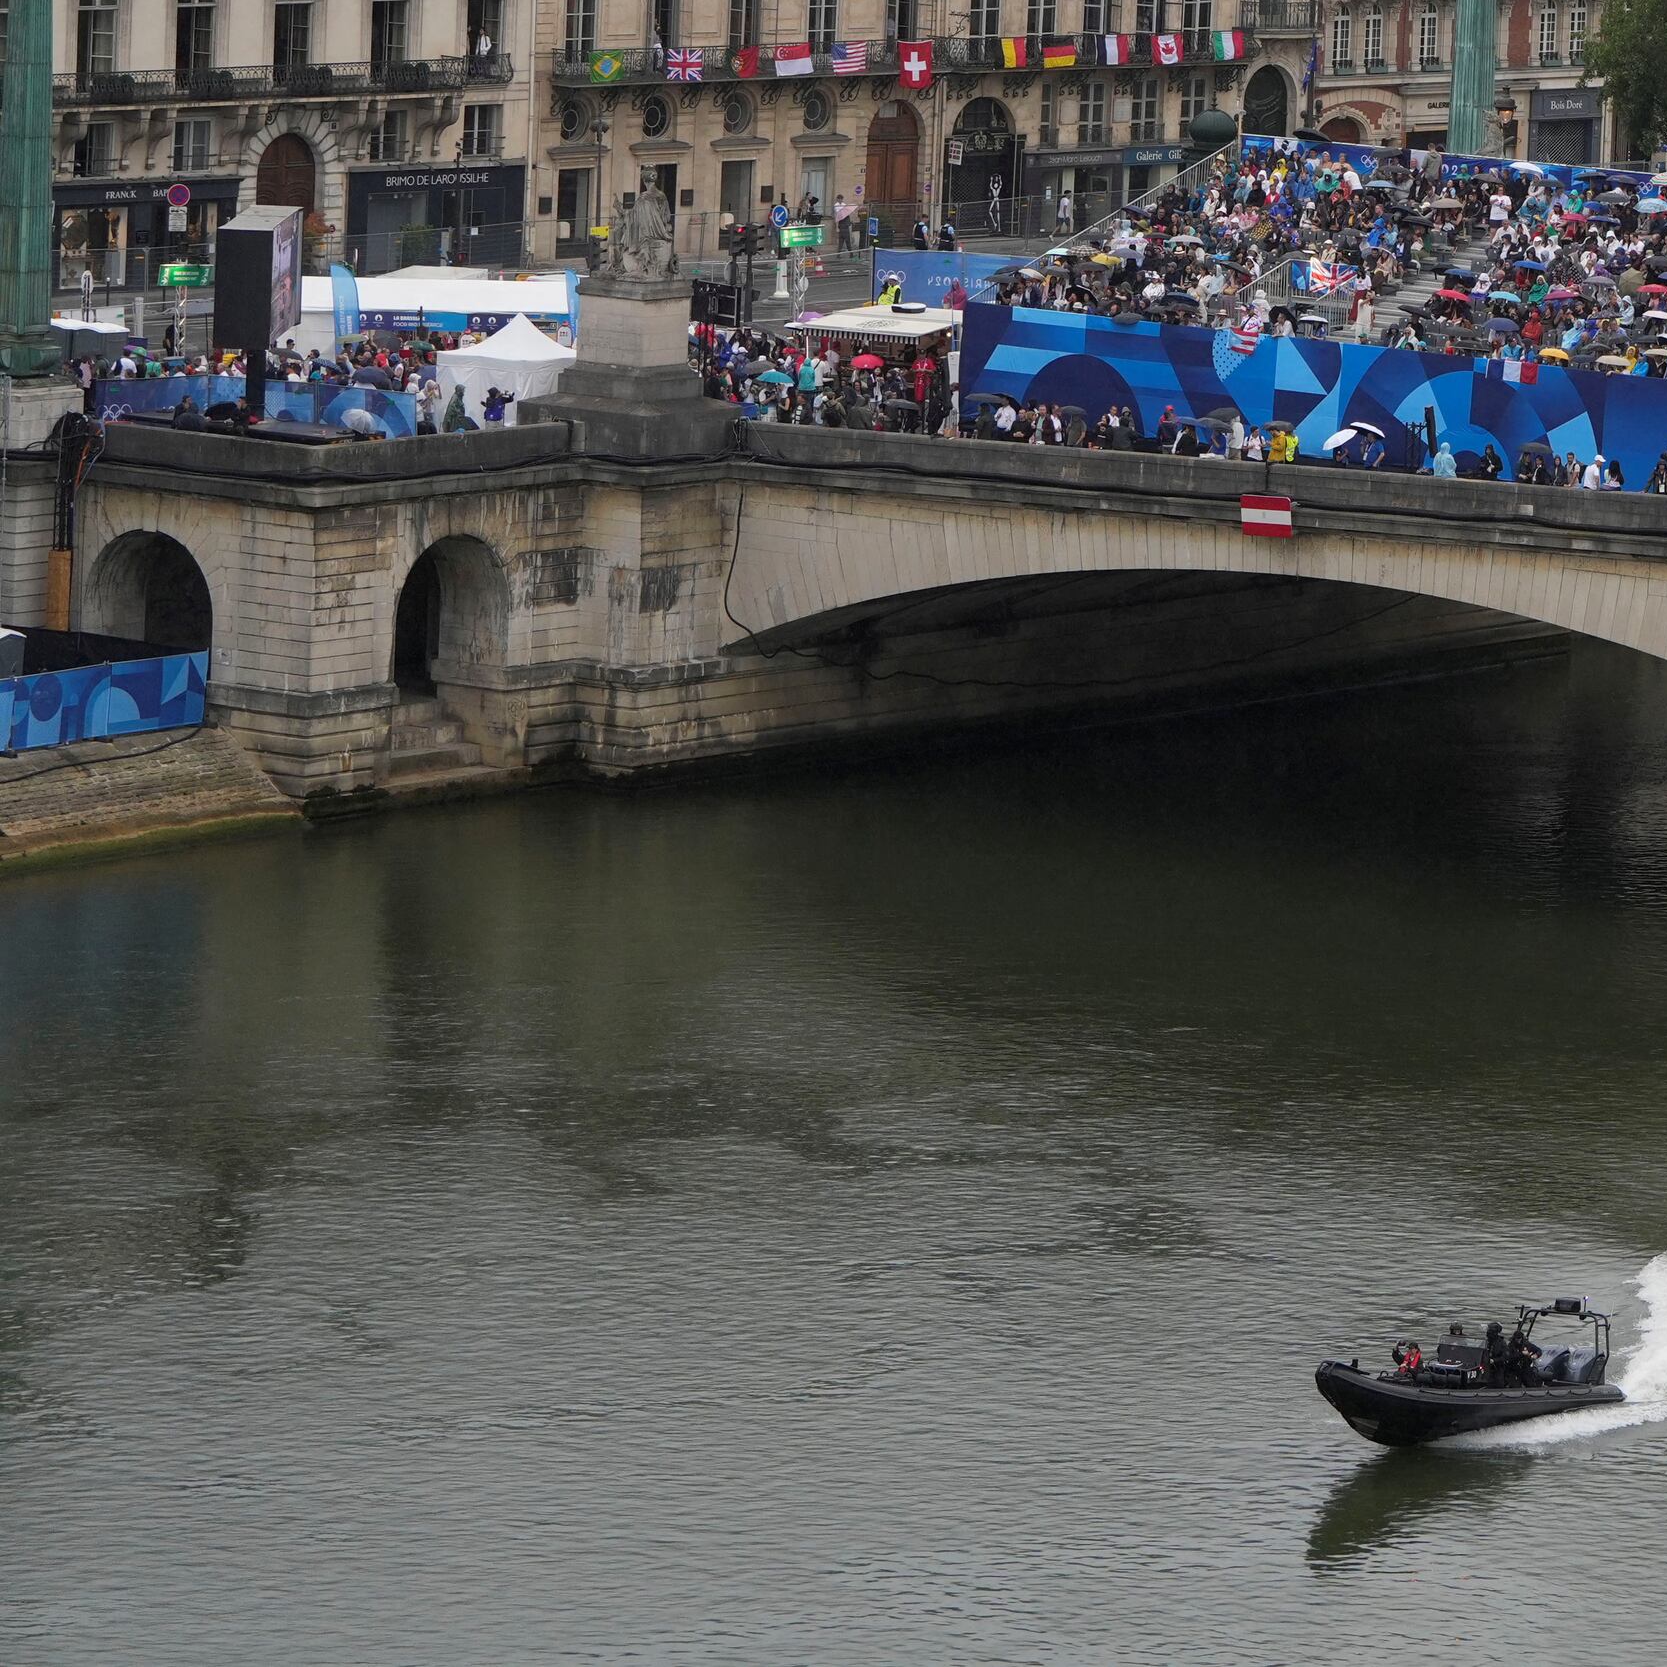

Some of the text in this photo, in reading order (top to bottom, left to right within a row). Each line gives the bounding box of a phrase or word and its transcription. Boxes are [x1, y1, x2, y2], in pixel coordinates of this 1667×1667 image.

[1550, 99, 1583, 110] Bois Doré
[1136, 149, 1163, 161] Galerie
[386, 175, 415, 187] BRIMO
[417, 175, 429, 186] DE
[105, 189, 137, 200] FRANCK
